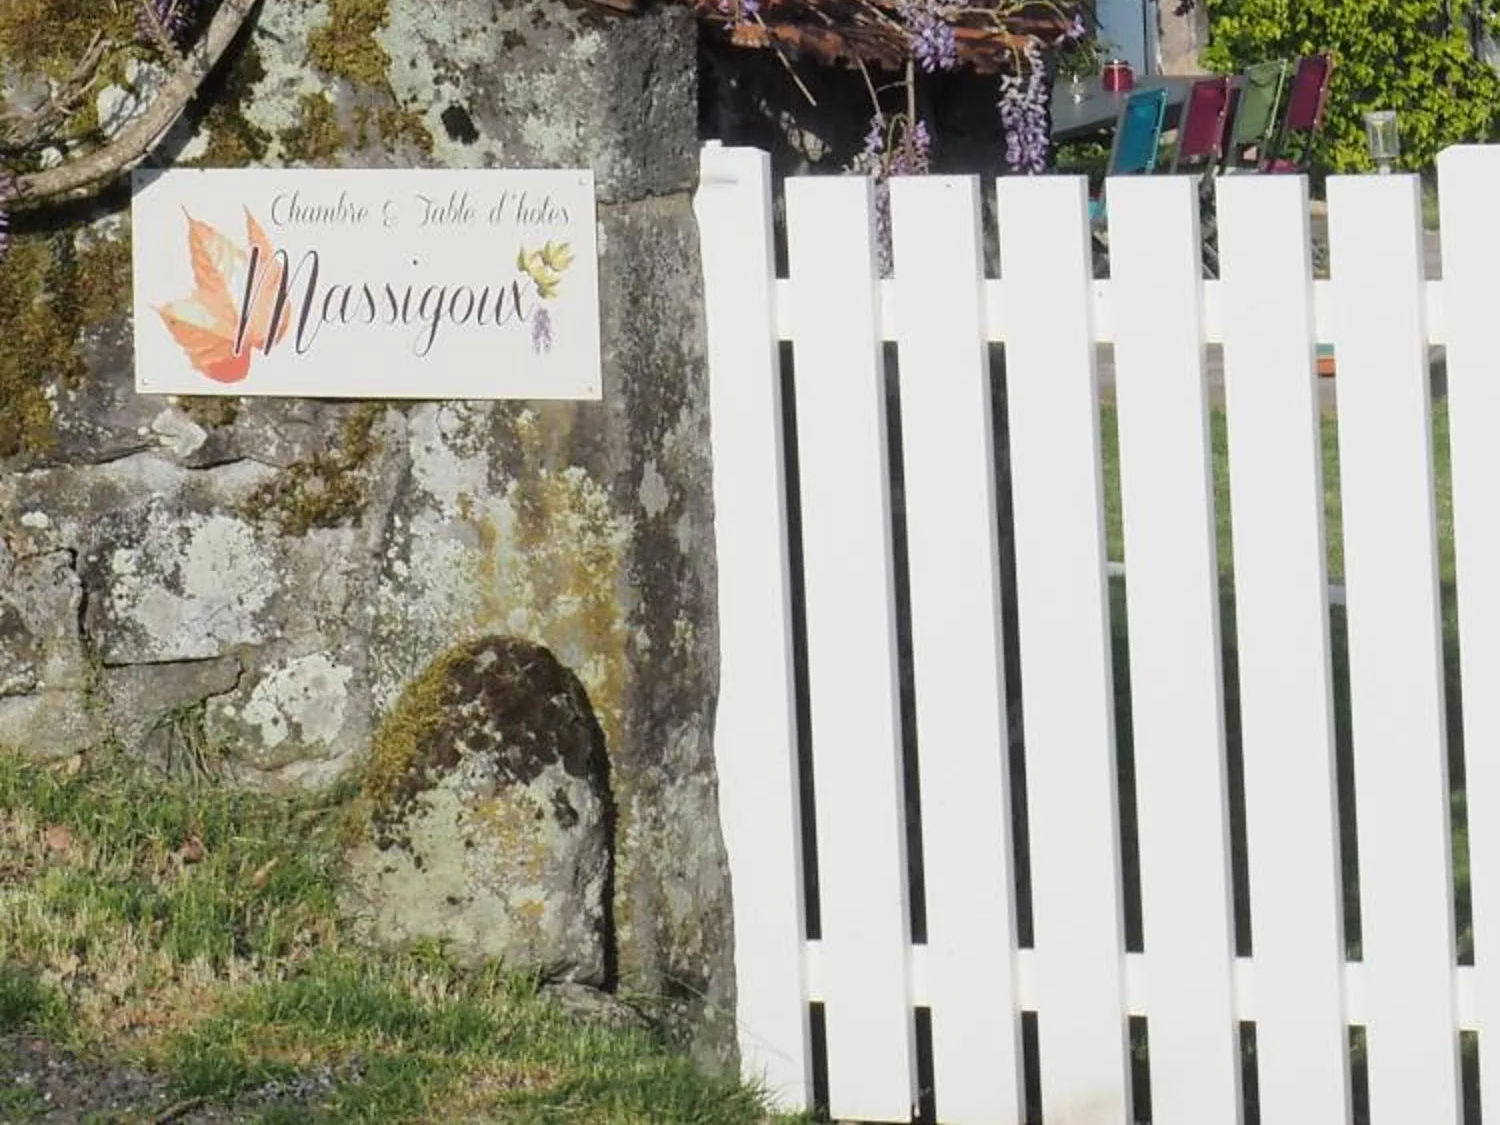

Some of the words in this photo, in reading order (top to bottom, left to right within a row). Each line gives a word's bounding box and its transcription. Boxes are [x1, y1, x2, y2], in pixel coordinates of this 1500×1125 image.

[271, 189, 369, 226] Chambre
[416, 189, 475, 227] Table
[233, 245, 537, 357] Massigoux
